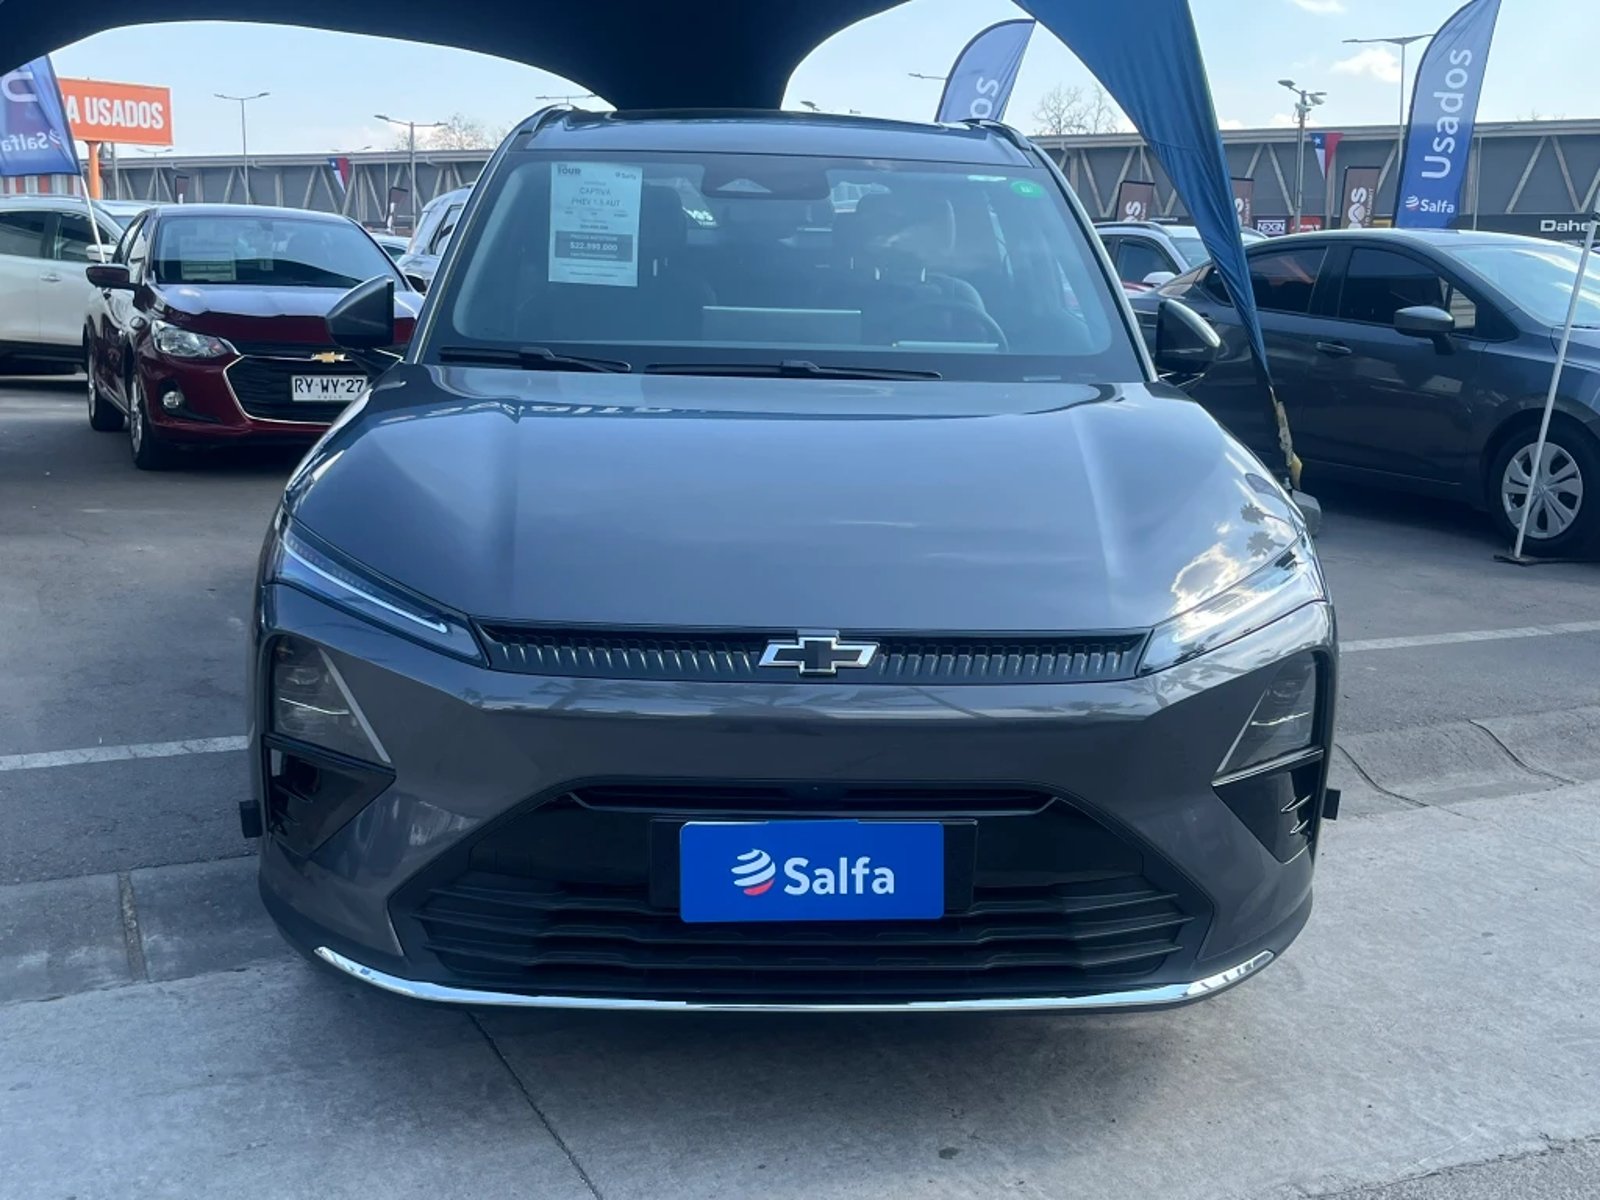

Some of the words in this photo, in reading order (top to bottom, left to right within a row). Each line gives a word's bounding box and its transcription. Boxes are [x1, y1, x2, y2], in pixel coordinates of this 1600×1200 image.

[84, 96, 164, 130] USADOS
[1422, 49, 1472, 180] Usados
[1420, 199, 1455, 214] Salfa
[783, 856, 895, 895] Salfa
